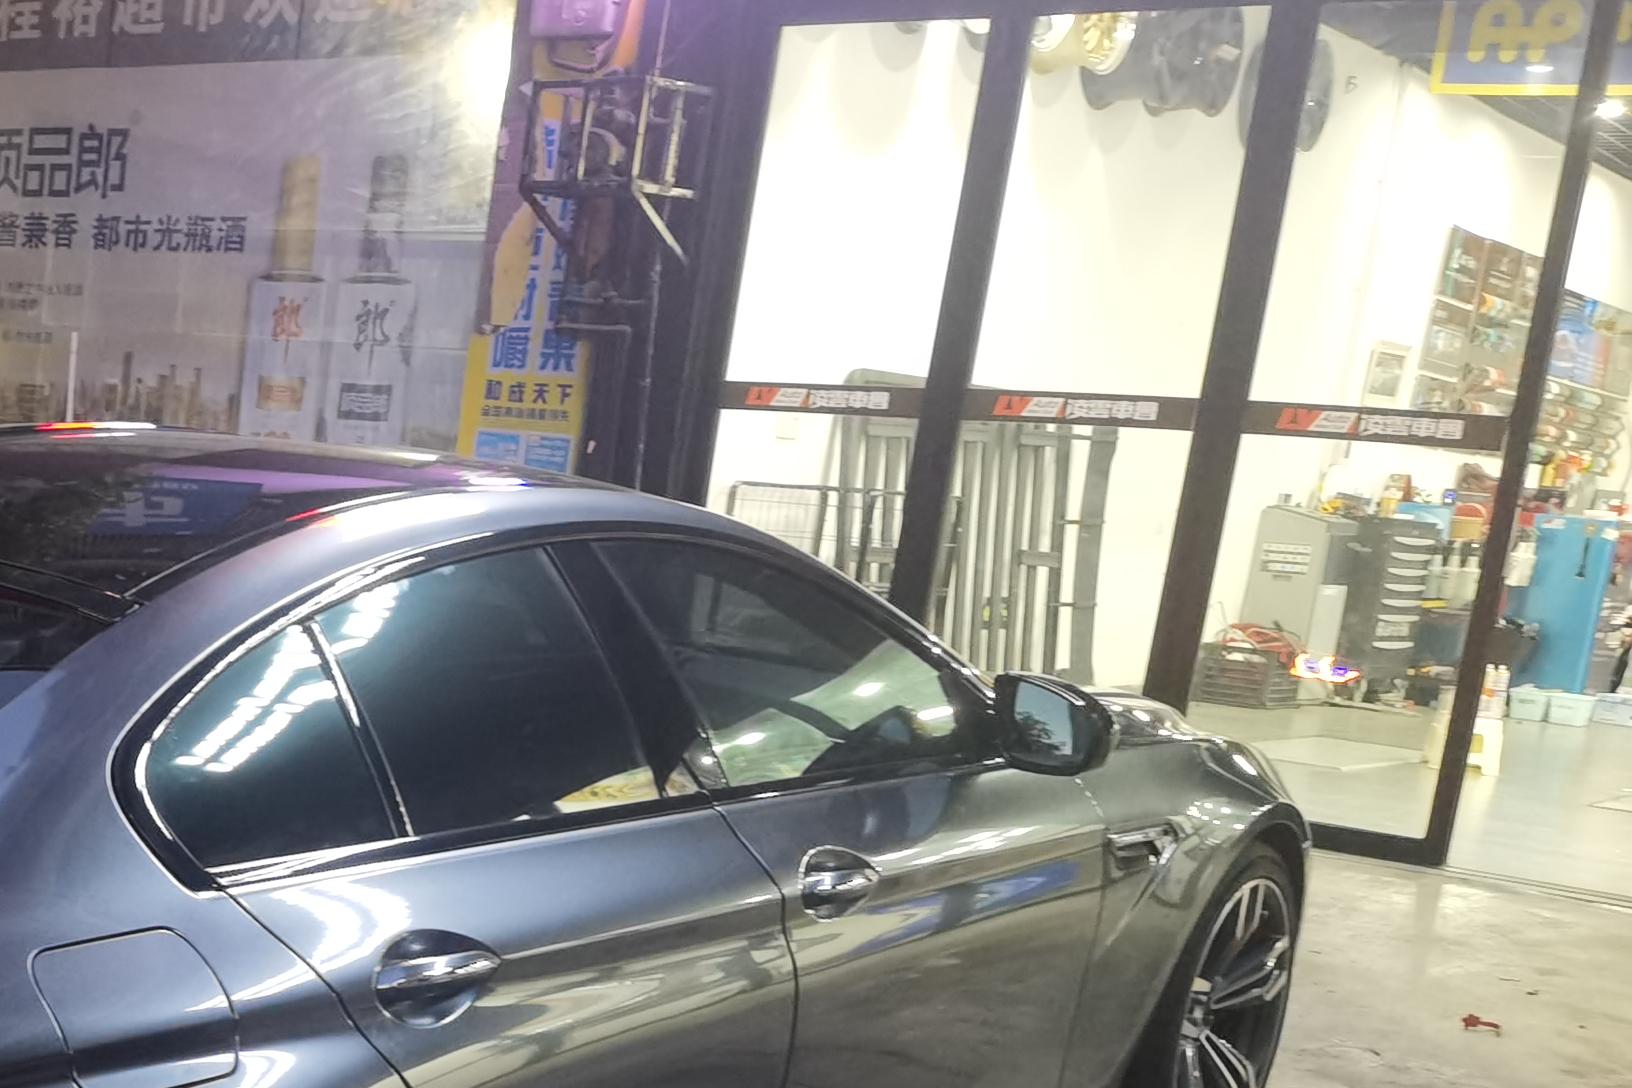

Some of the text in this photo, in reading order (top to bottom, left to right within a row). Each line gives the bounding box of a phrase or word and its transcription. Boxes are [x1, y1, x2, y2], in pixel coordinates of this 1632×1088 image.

[91, 214, 248, 254] 都市光瓶酒
